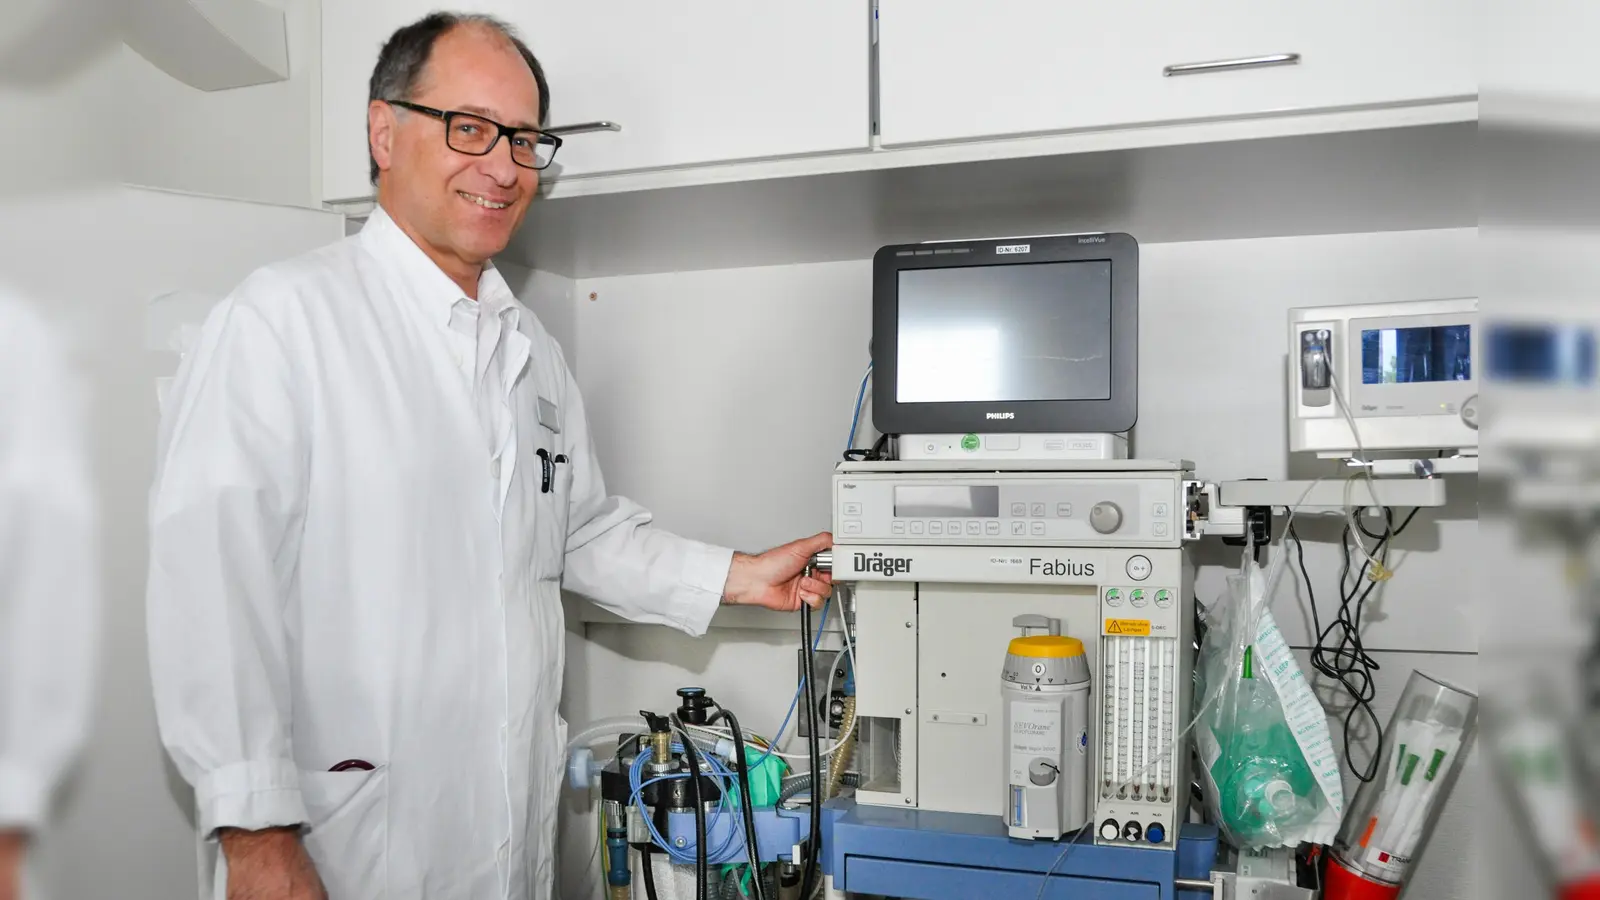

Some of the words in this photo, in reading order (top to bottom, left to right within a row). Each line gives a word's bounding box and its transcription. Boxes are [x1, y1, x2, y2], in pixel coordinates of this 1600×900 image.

[986, 412, 1015, 420] PHILIPS
[854, 552, 913, 577] Dräger
[1029, 558, 1095, 576] Fabius
